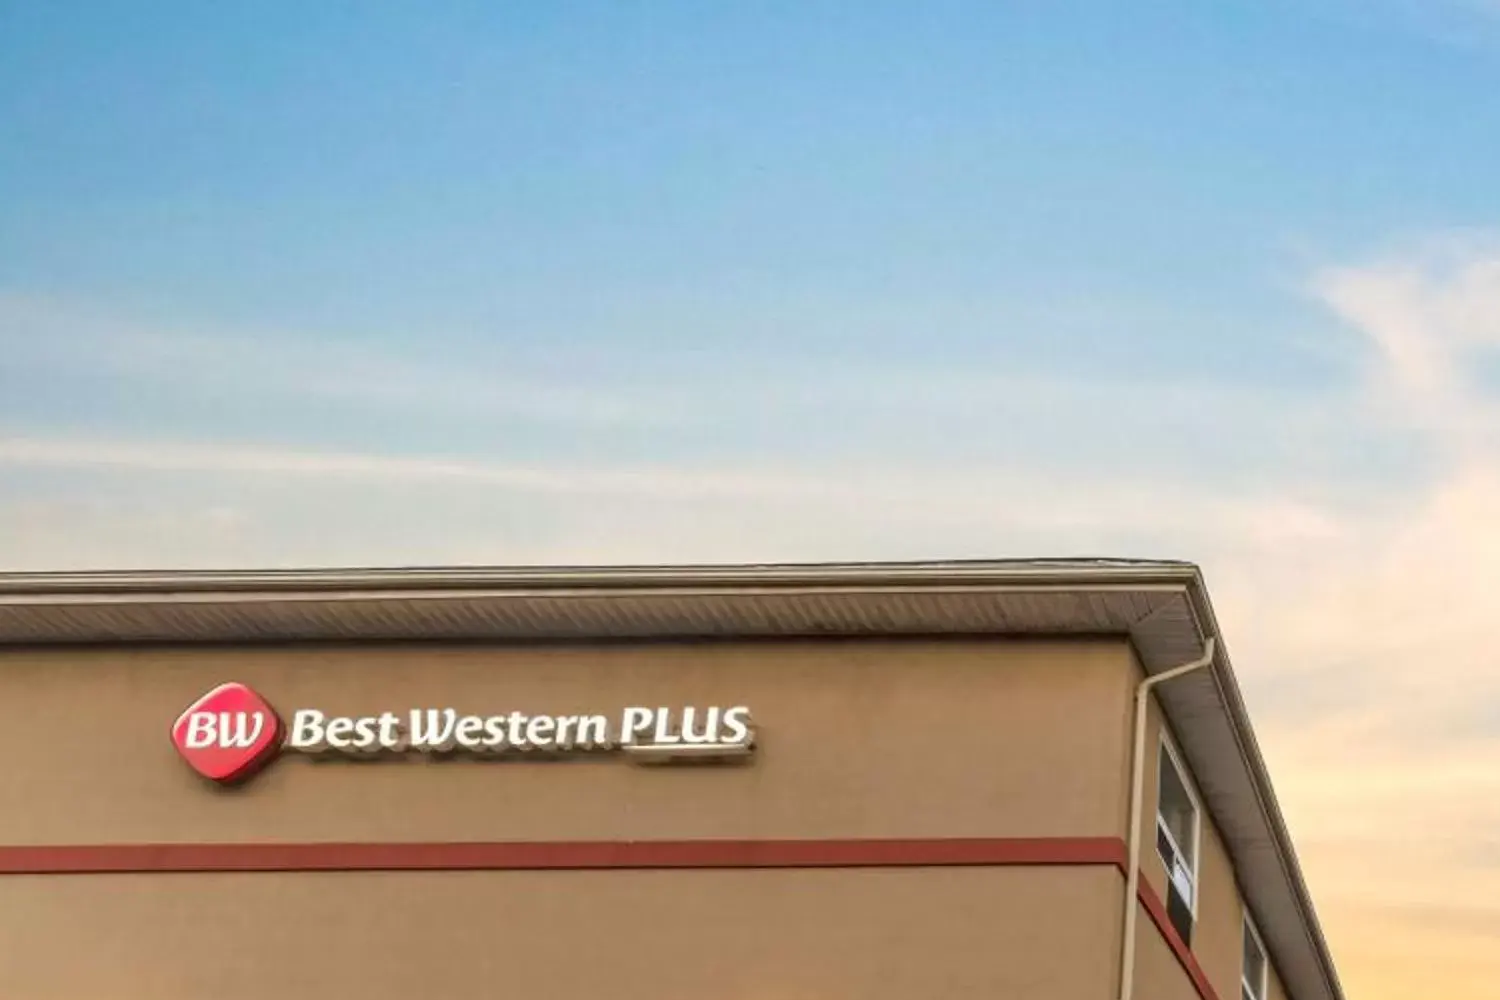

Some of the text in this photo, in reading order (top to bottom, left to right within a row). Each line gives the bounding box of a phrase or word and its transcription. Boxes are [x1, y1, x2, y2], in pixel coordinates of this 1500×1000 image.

[185, 711, 263, 749] BW
[291, 706, 751, 748] Best Western PLUS
